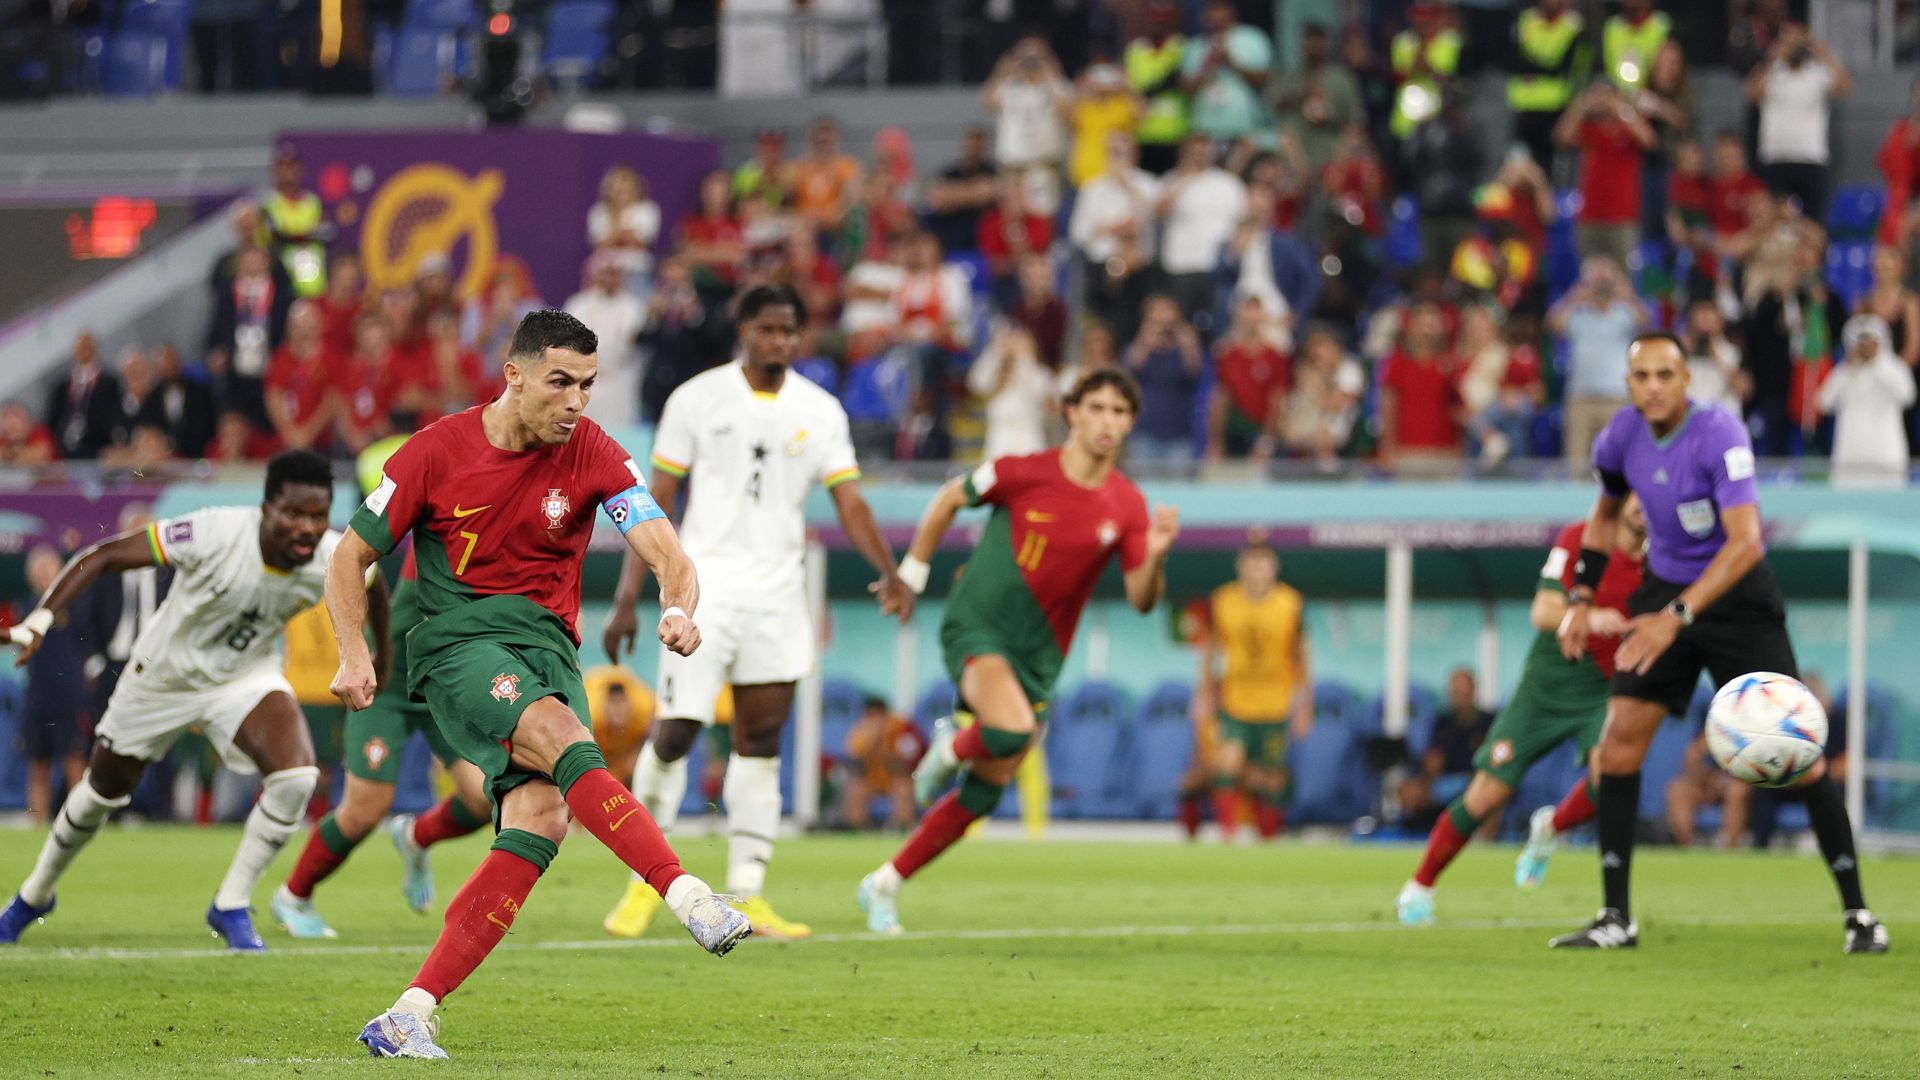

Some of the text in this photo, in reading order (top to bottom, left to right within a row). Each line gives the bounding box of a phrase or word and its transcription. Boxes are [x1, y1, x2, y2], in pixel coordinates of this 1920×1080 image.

[744, 470, 761, 505] 4
[455, 530, 478, 576] 7
[1016, 530, 1047, 571] 11
